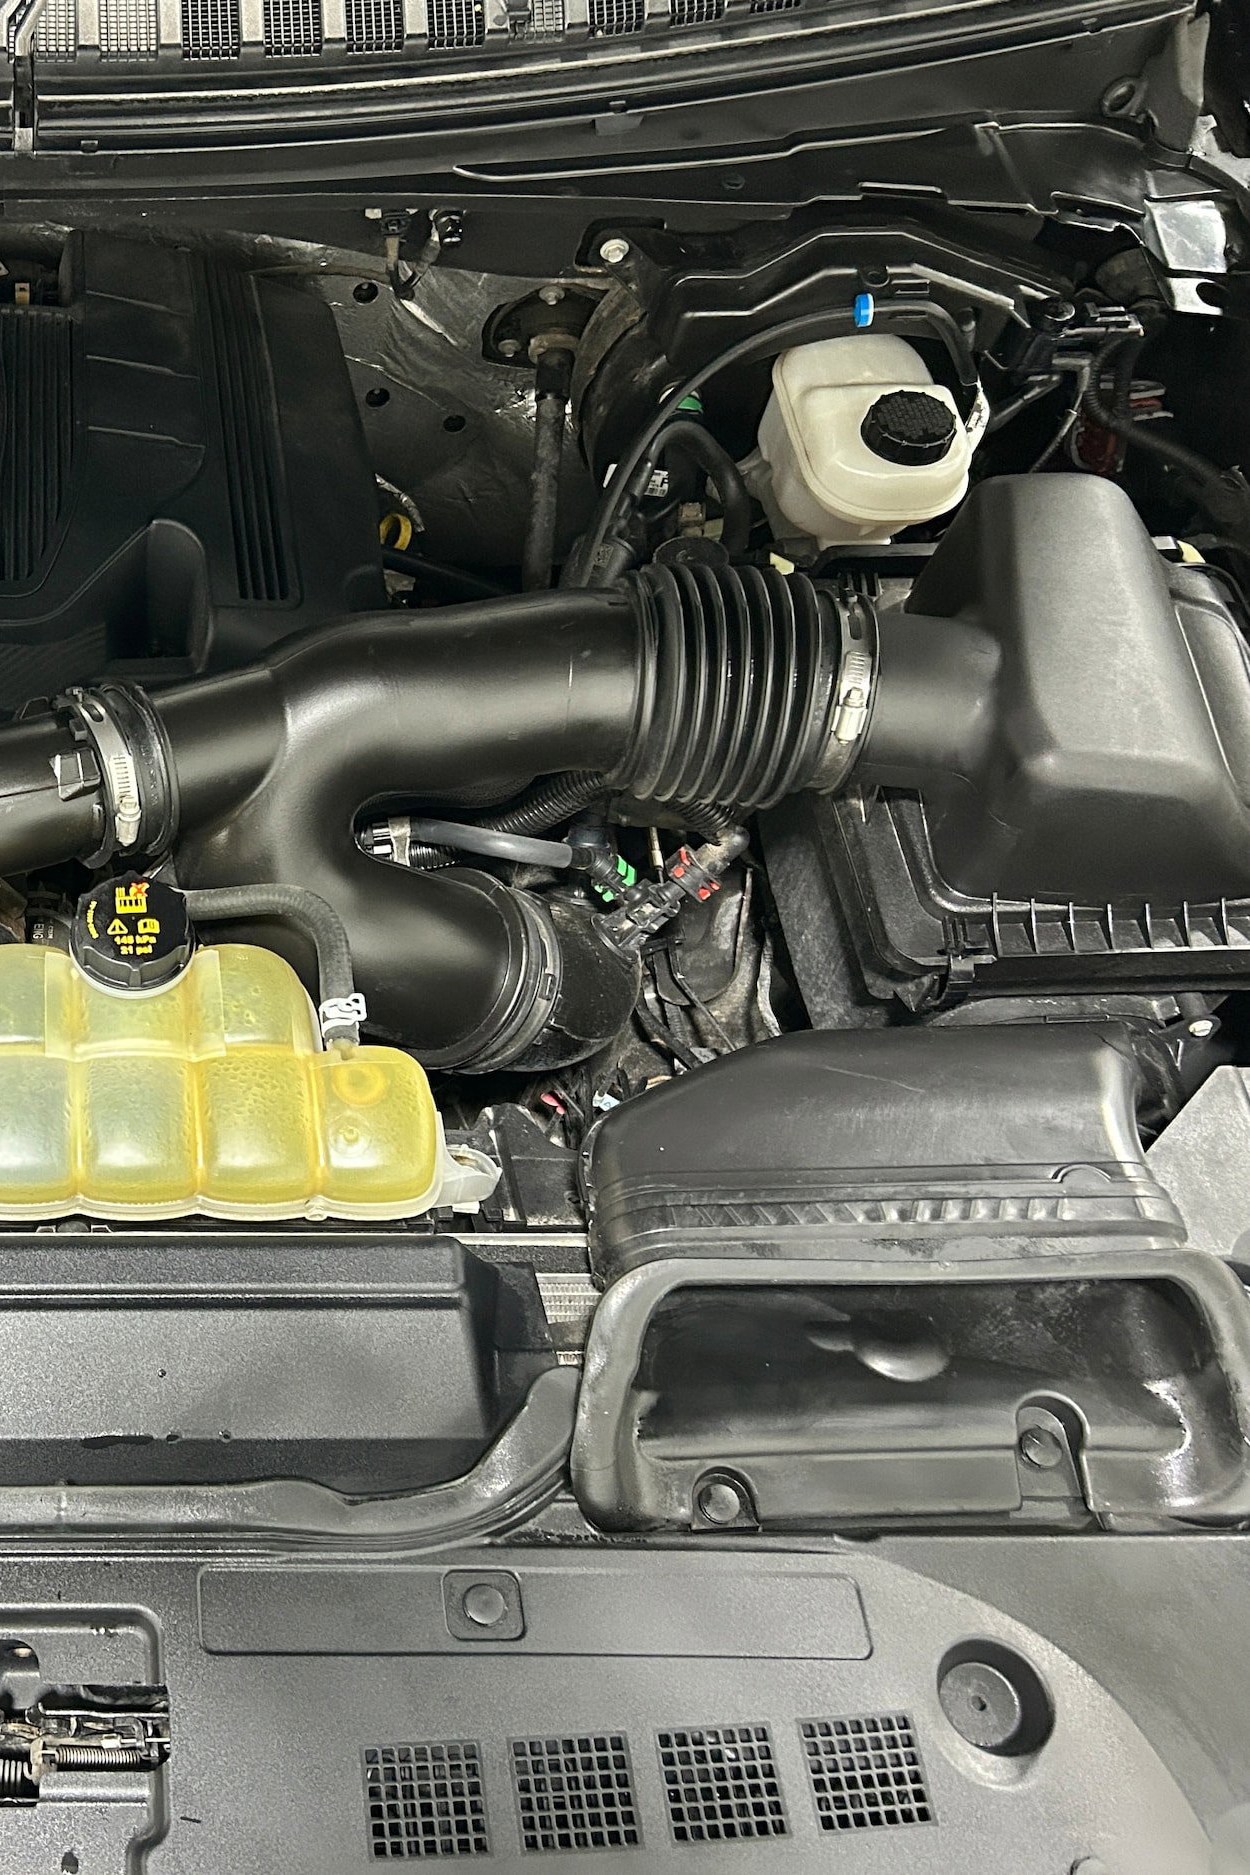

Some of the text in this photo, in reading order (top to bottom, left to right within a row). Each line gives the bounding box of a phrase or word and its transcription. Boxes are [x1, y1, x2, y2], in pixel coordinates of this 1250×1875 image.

[32, 923, 45, 939] ENG
[135, 935, 157, 944] kPa
[120, 945, 153, 955] 21 psi
